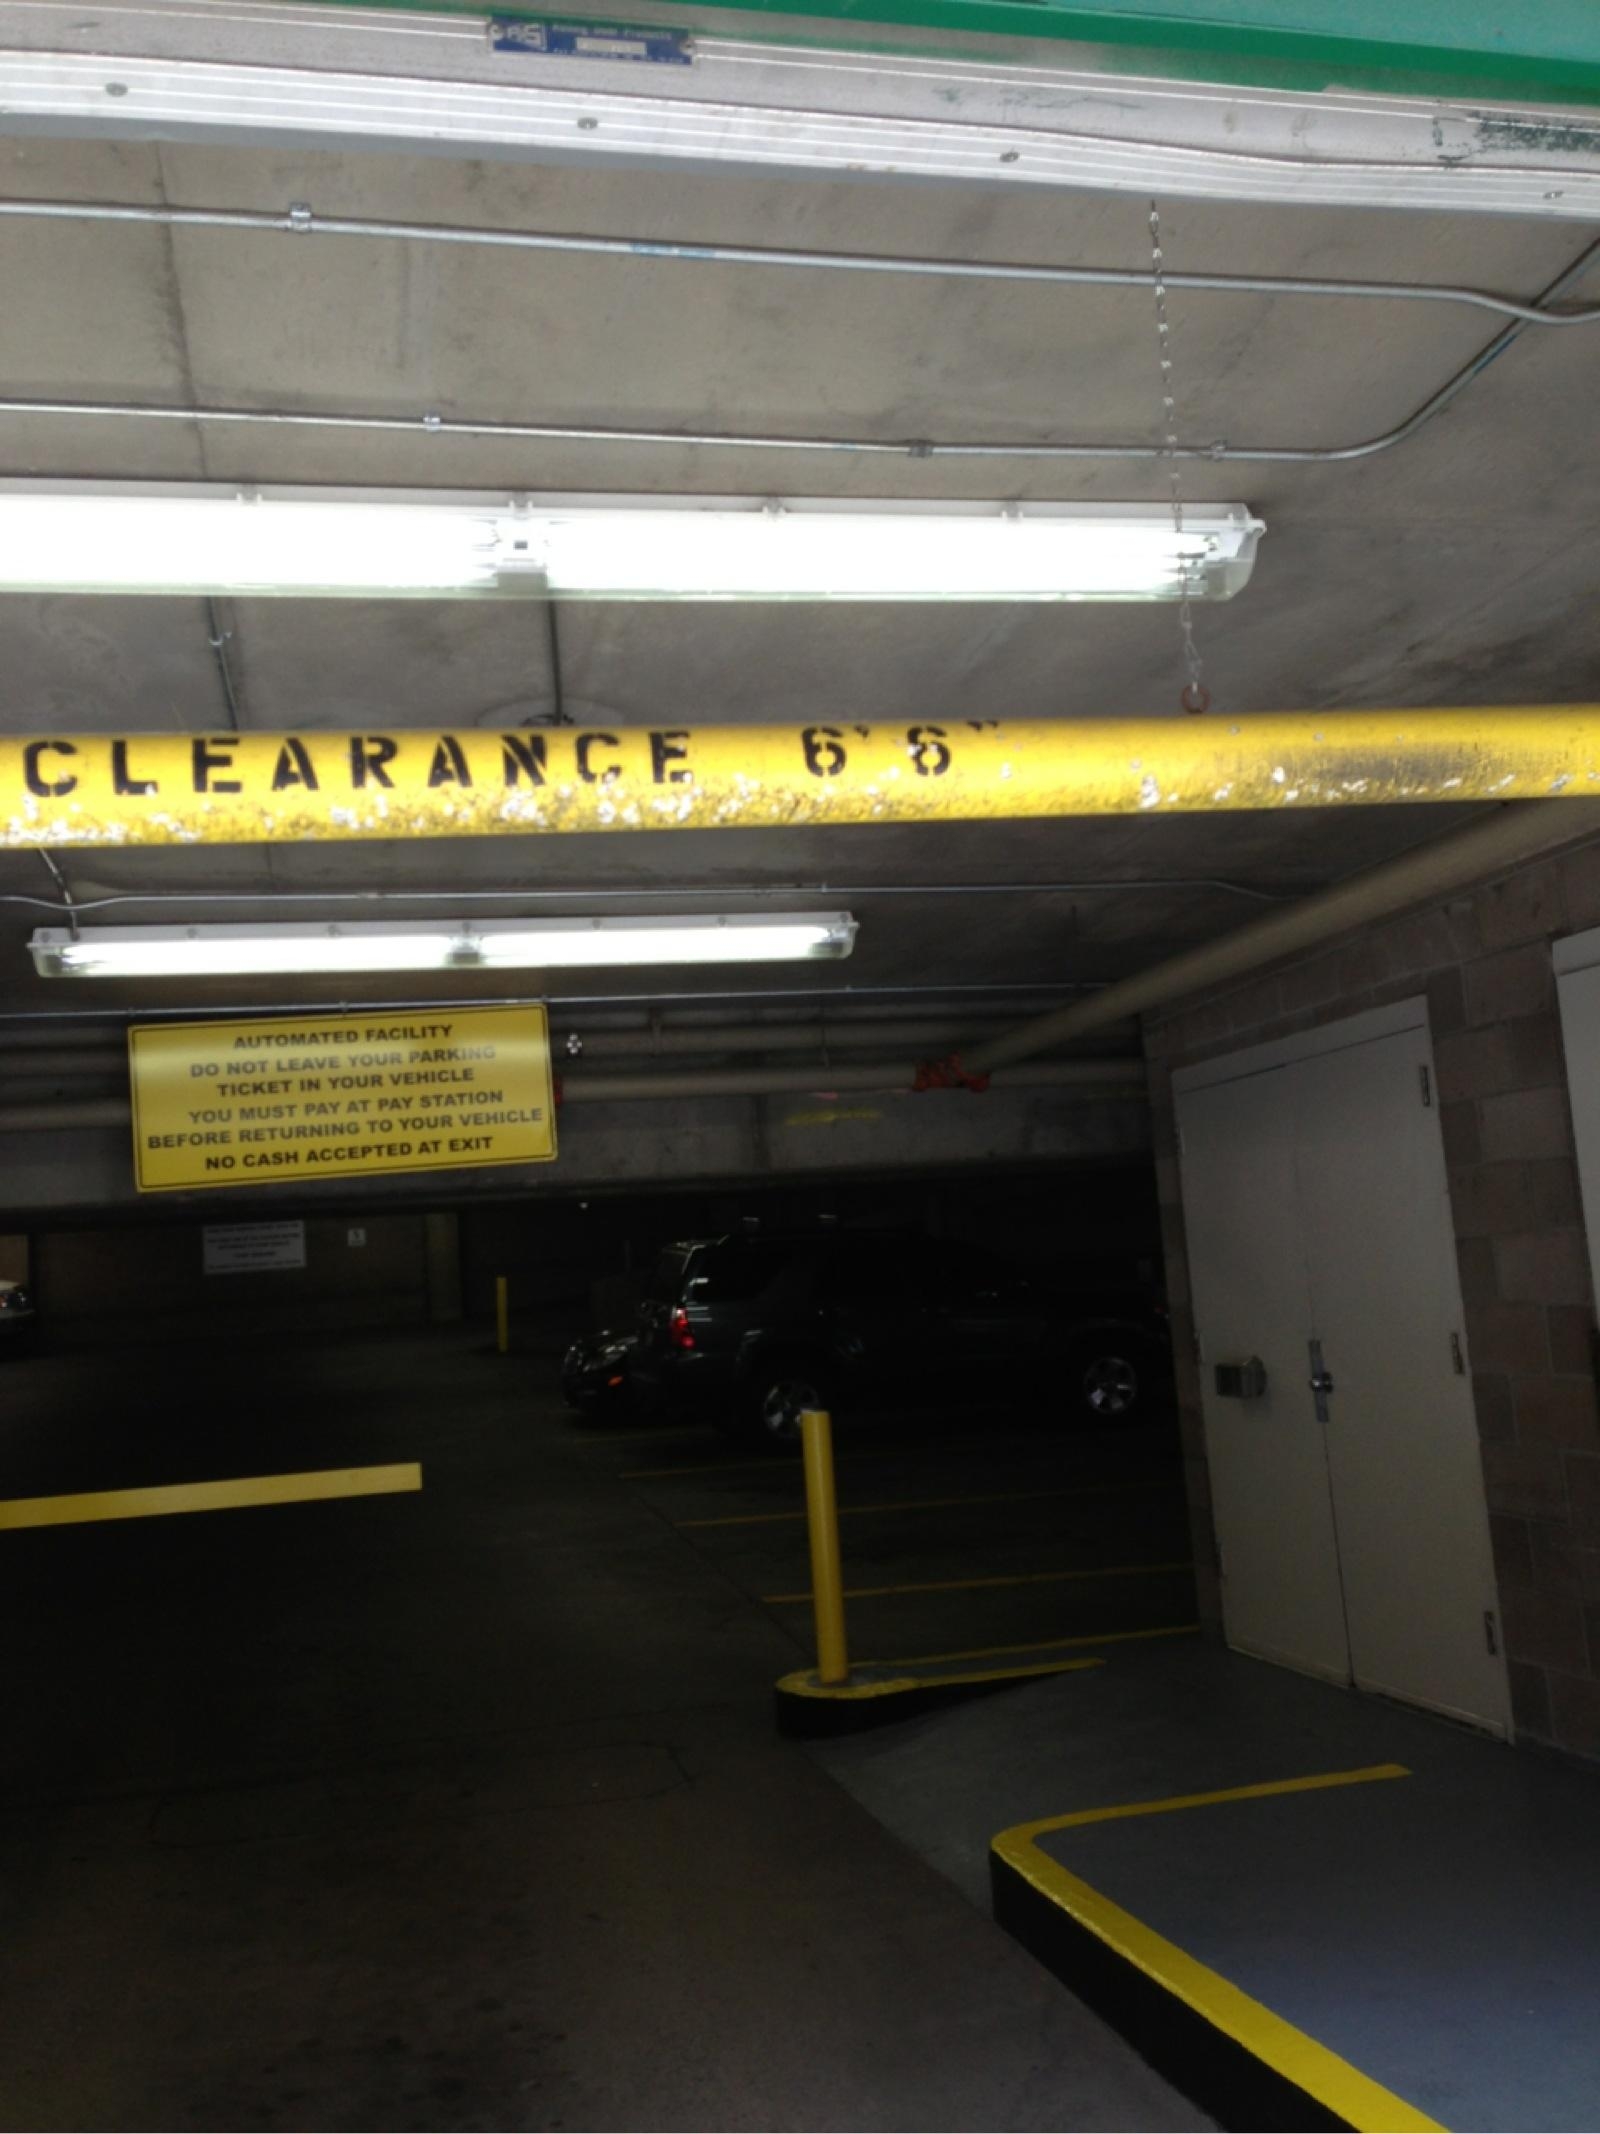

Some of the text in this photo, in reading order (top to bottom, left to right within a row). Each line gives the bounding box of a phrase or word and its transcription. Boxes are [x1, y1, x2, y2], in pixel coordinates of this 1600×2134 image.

[23, 730, 693, 797] CLEARANCE
[234, 1025, 453, 1049] AUTOMATED FACILITY
[191, 1045, 496, 1078] DO NOT LEAVE YOUR PARKING
[217, 1068, 474, 1097] TICKET IN YOUR VEHICLE
[189, 1089, 503, 1124] YOU MUST PAY AT PAY STATION
[148, 1108, 542, 1149] BEFORE RETURNING TO YOUR VEHICLE
[206, 1135, 493, 1170] NO CASH ACCEPTED AT EXIT
